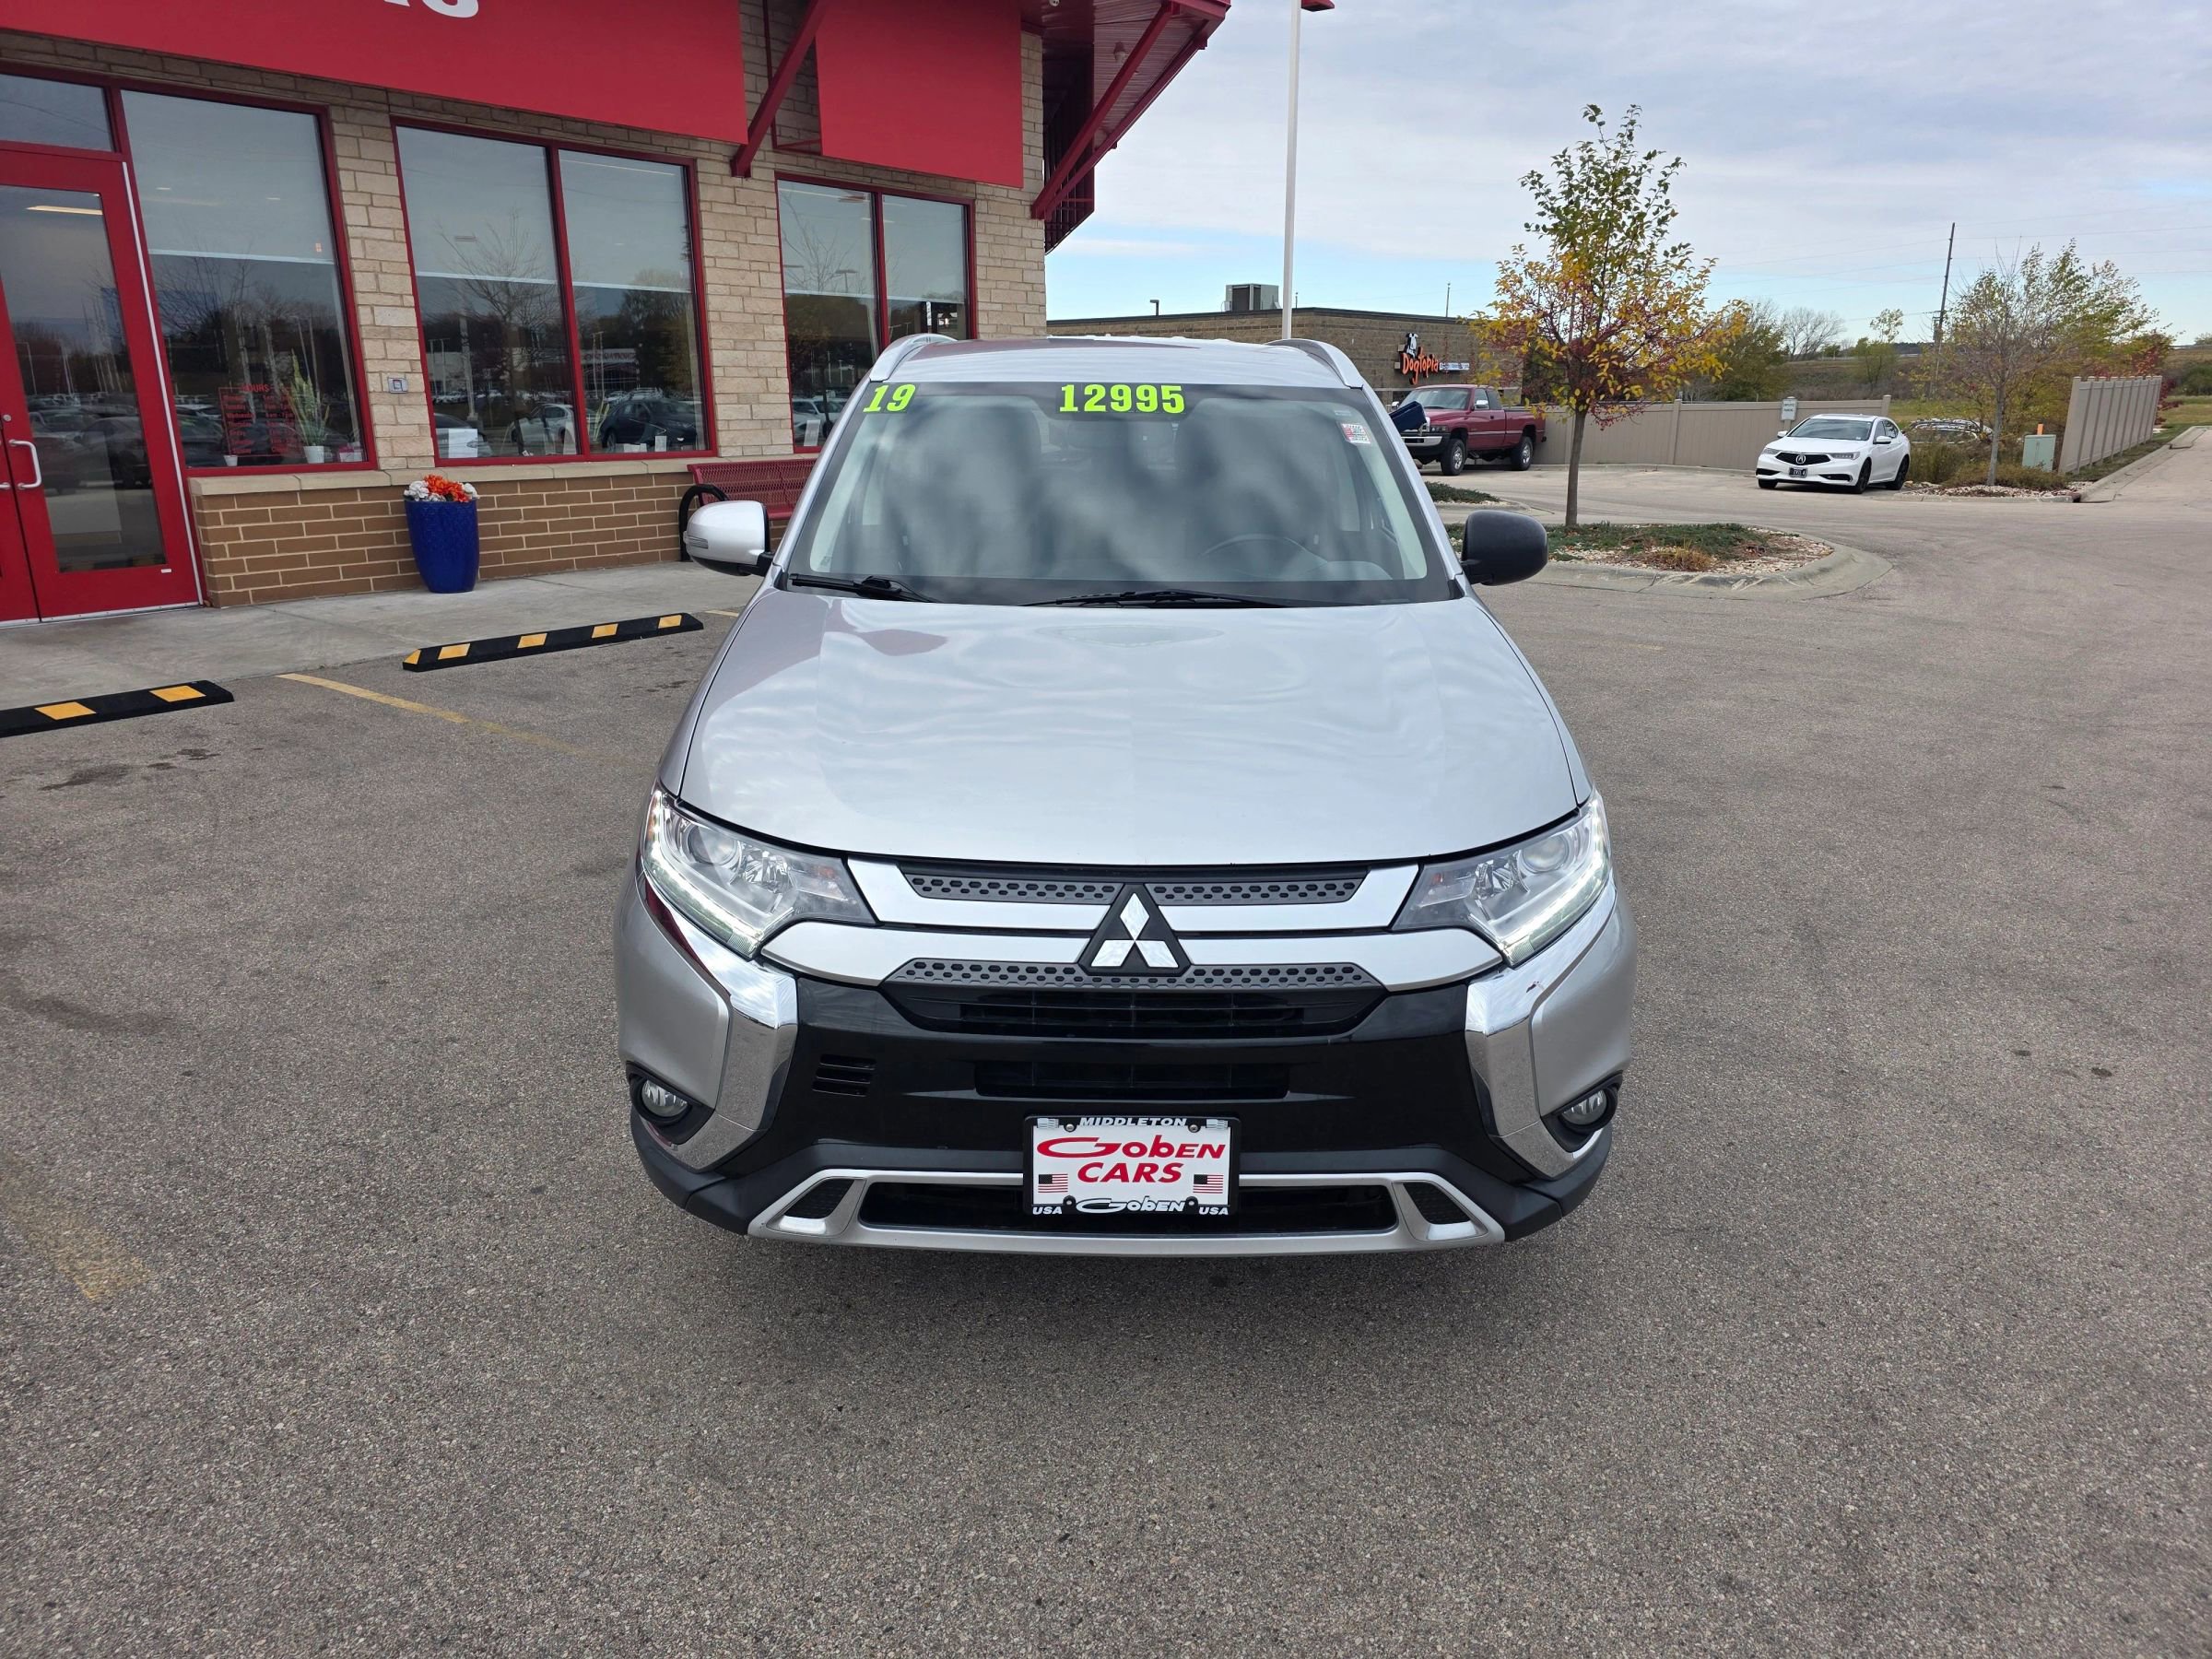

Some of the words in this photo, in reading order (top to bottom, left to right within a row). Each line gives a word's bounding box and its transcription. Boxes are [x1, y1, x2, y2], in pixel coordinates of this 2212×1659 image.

[1402, 347, 1439, 384] Dogtopia
[241, 383, 270, 393] HOURS
[863, 383, 916, 413] 19
[1059, 383, 1185, 414] 12995
[1078, 1117, 1187, 1127] MIDDLETON
[1077, 1162, 1184, 1183] CARS
[1032, 1206, 1063, 1215] USA
[1198, 1206, 1229, 1216] USA
